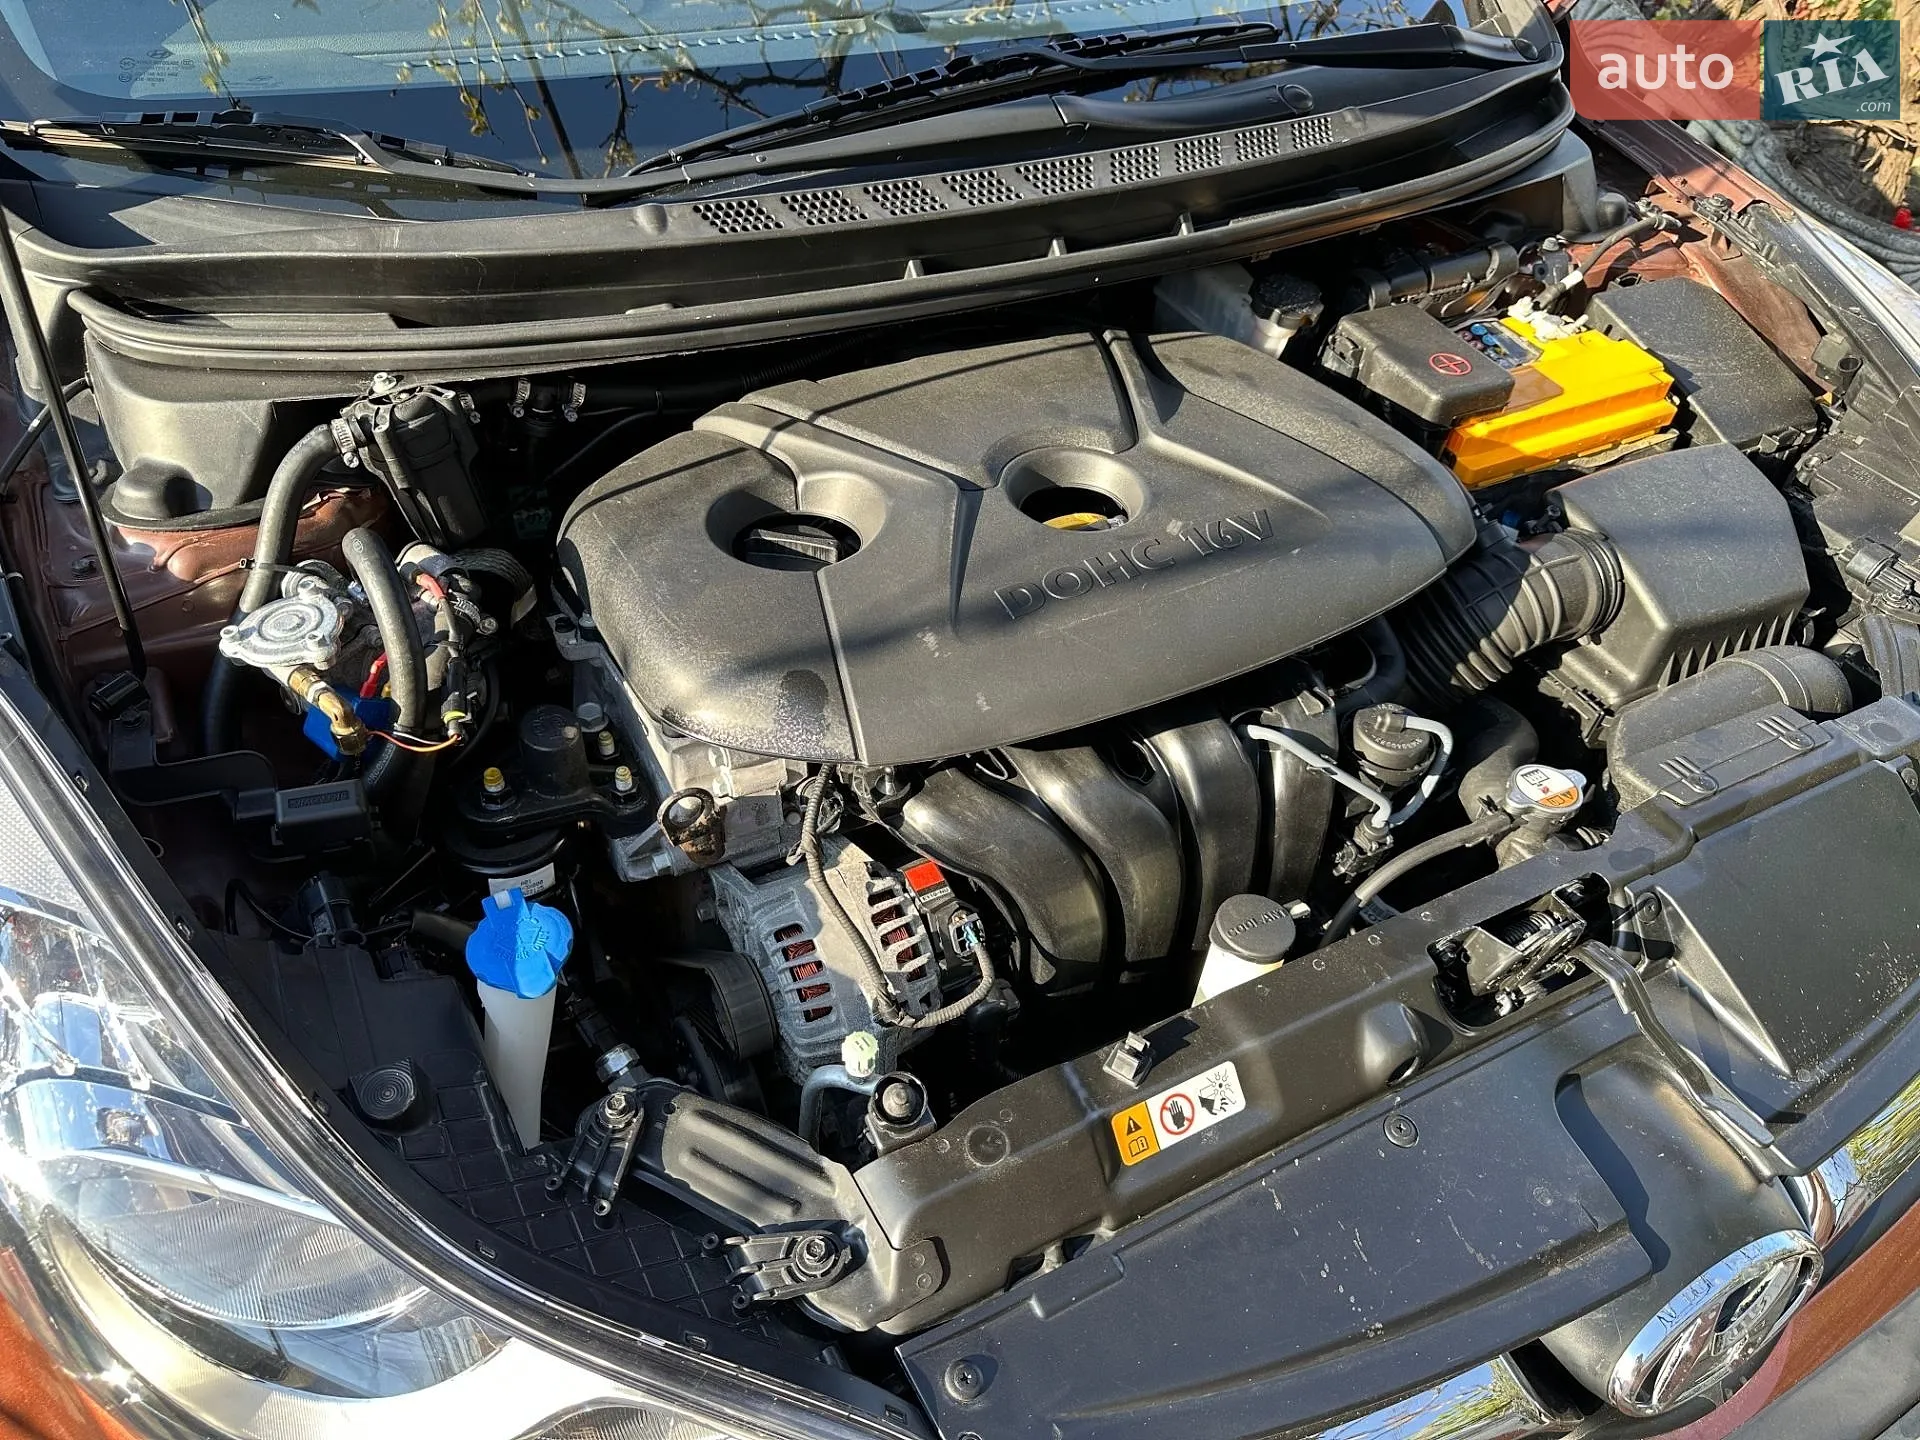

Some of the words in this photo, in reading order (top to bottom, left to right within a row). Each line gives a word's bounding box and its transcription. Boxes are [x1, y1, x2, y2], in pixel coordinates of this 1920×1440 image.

[993, 538, 1176, 620] DOHC
[1179, 509, 1274, 557] 16V
[1227, 909, 1287, 938] COOLANT
